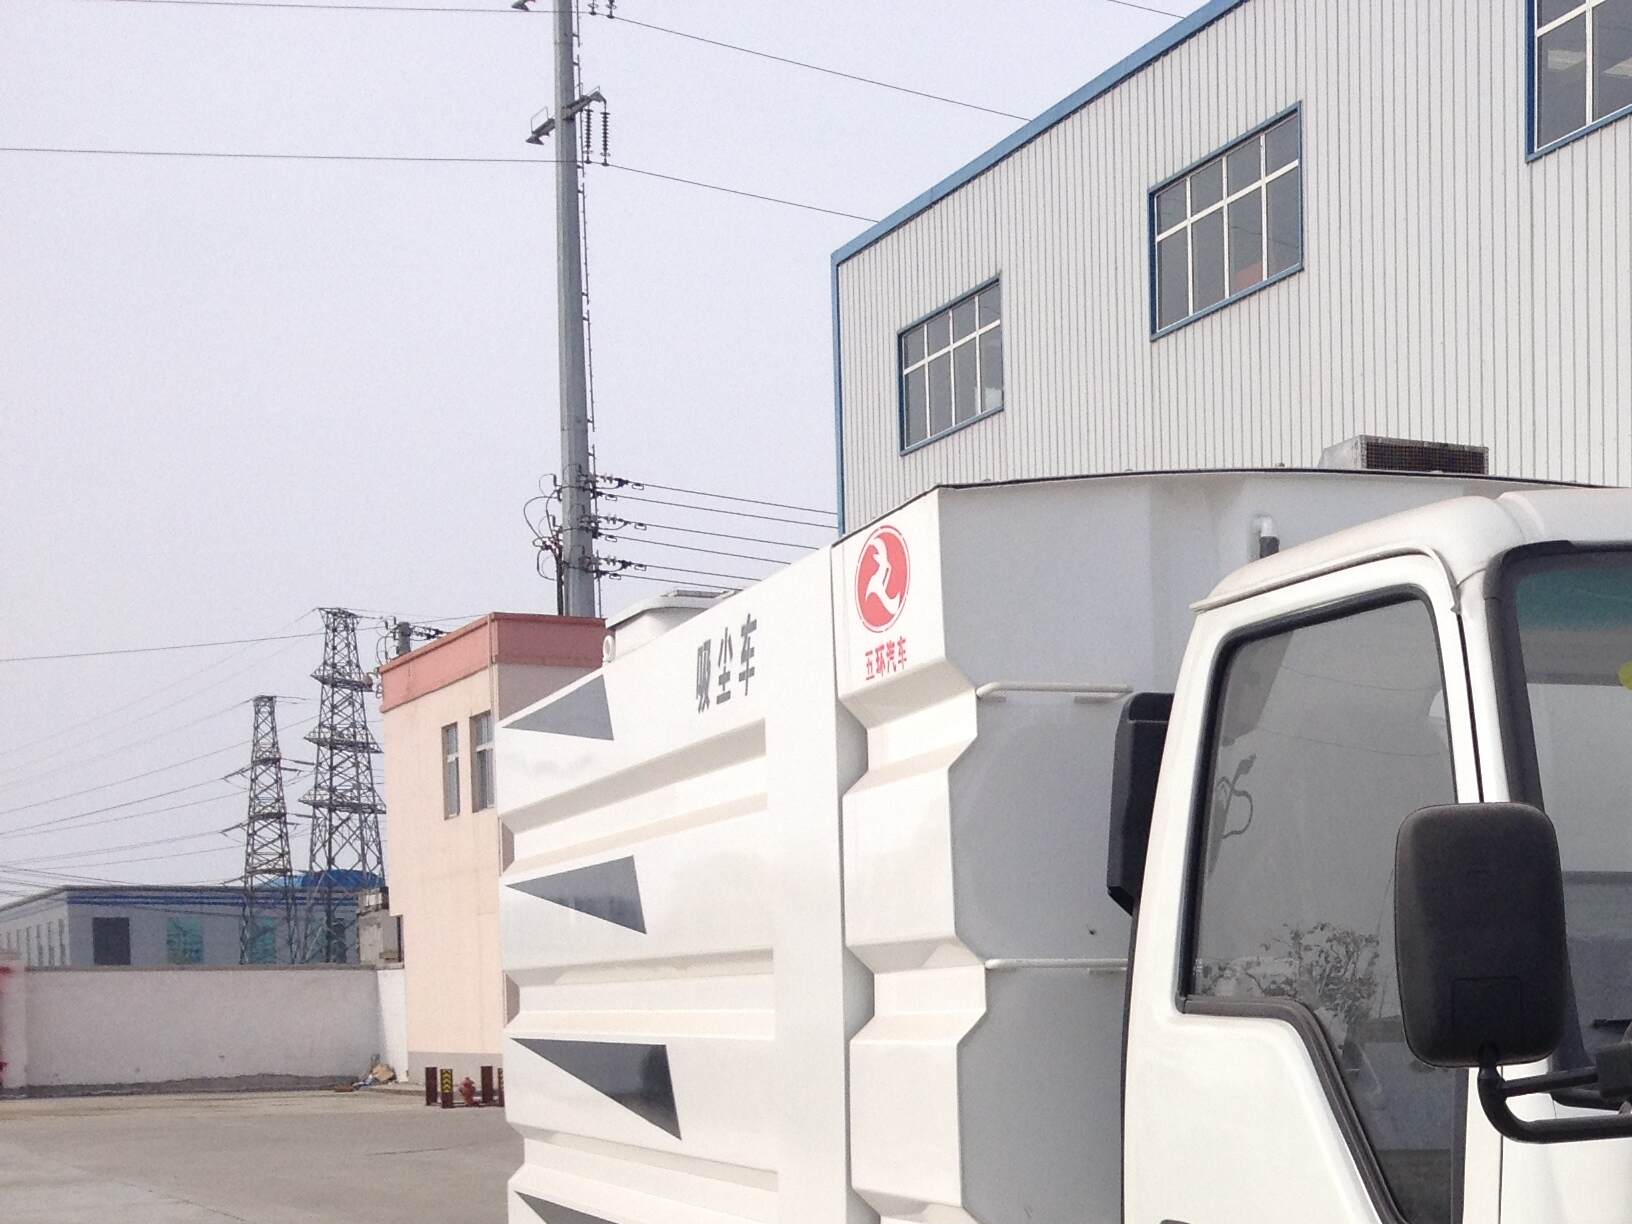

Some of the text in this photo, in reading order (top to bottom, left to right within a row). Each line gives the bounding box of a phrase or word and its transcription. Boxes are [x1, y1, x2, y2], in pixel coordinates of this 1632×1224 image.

[696, 613, 757, 713] 吸尘车
[865, 636, 907, 681] 五环汽车
